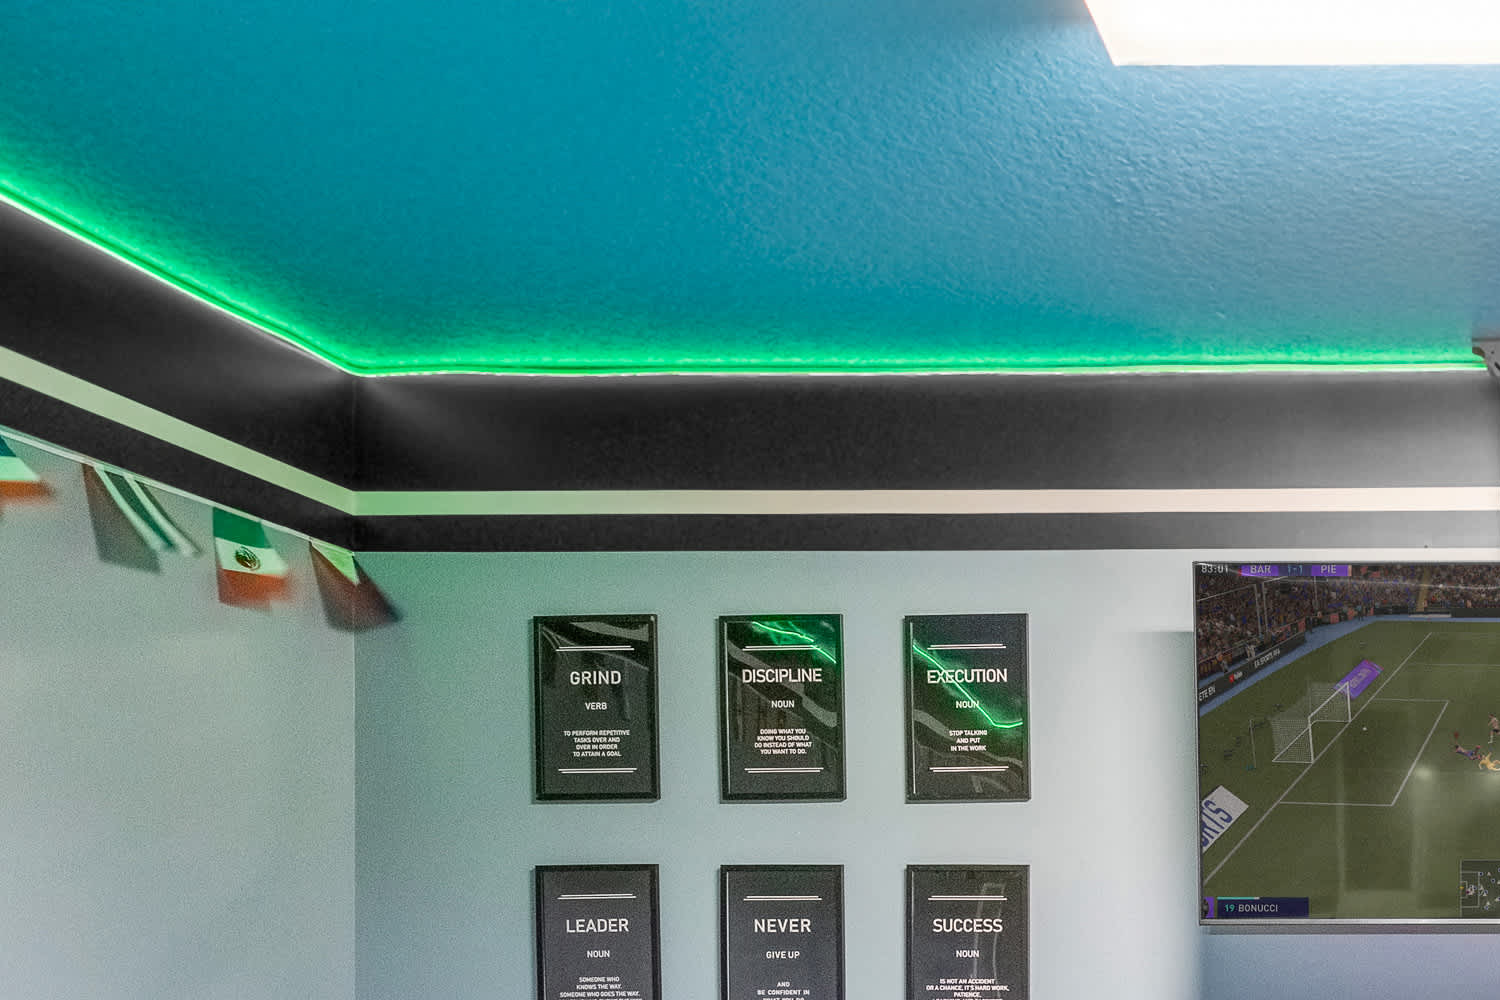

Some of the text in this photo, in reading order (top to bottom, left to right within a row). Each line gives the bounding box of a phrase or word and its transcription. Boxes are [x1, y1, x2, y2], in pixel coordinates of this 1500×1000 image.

[570, 671, 621, 684] GRIND
[742, 669, 822, 682] DISCIPLINE
[927, 669, 1008, 683] EXECUTION
[566, 919, 629, 932] LEADER
[754, 919, 812, 932] NEVER
[933, 919, 1003, 932] SUCCESS
